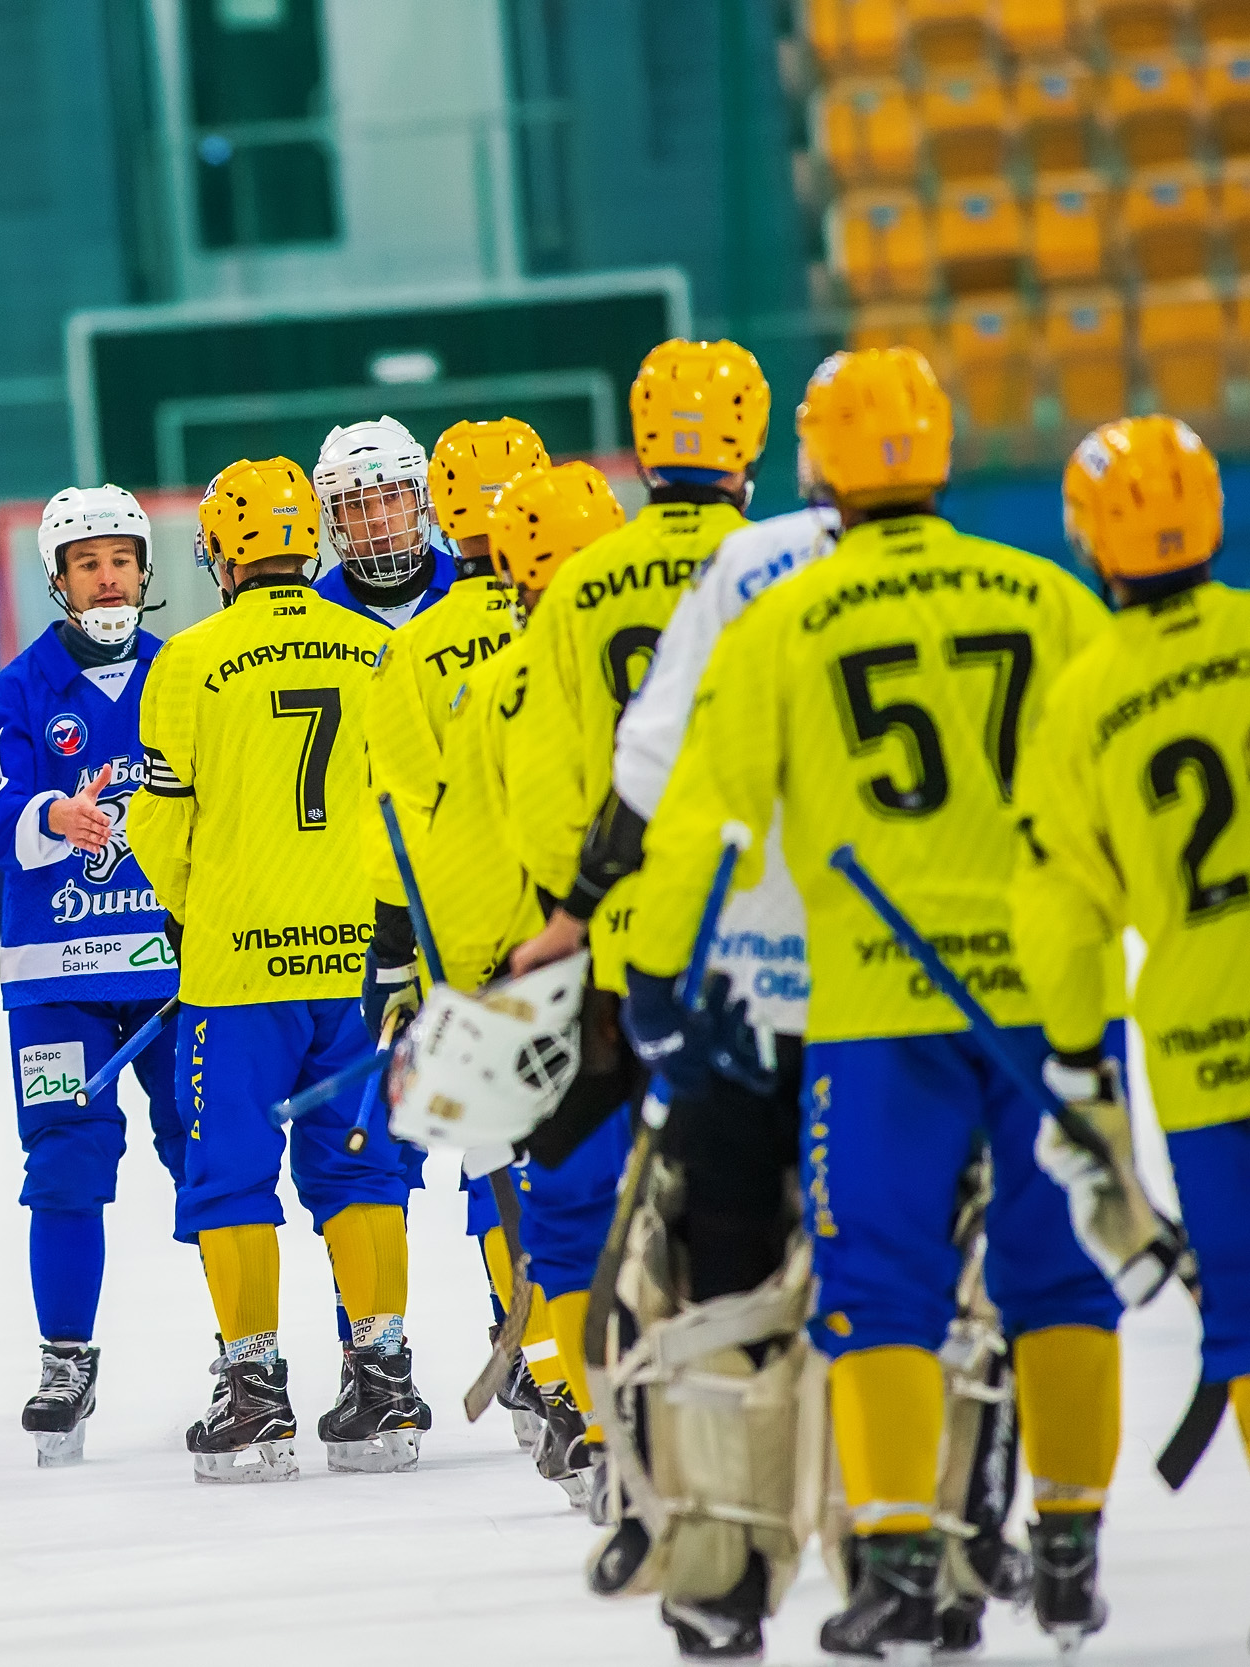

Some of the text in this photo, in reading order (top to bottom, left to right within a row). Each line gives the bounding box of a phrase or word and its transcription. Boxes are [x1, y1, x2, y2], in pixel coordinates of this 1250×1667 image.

[282, 524, 292, 546] 7
[98, 671, 126, 681] STEX
[826, 632, 1033, 821] 57
[271, 687, 342, 831] 7
[1142, 737, 1250, 928] 2
[62, 941, 122, 956] Ак Барс
[62, 960, 99, 972] Банк
[23, 1051, 61, 1063] Ак Барс
[23, 1066, 45, 1077] Банк
